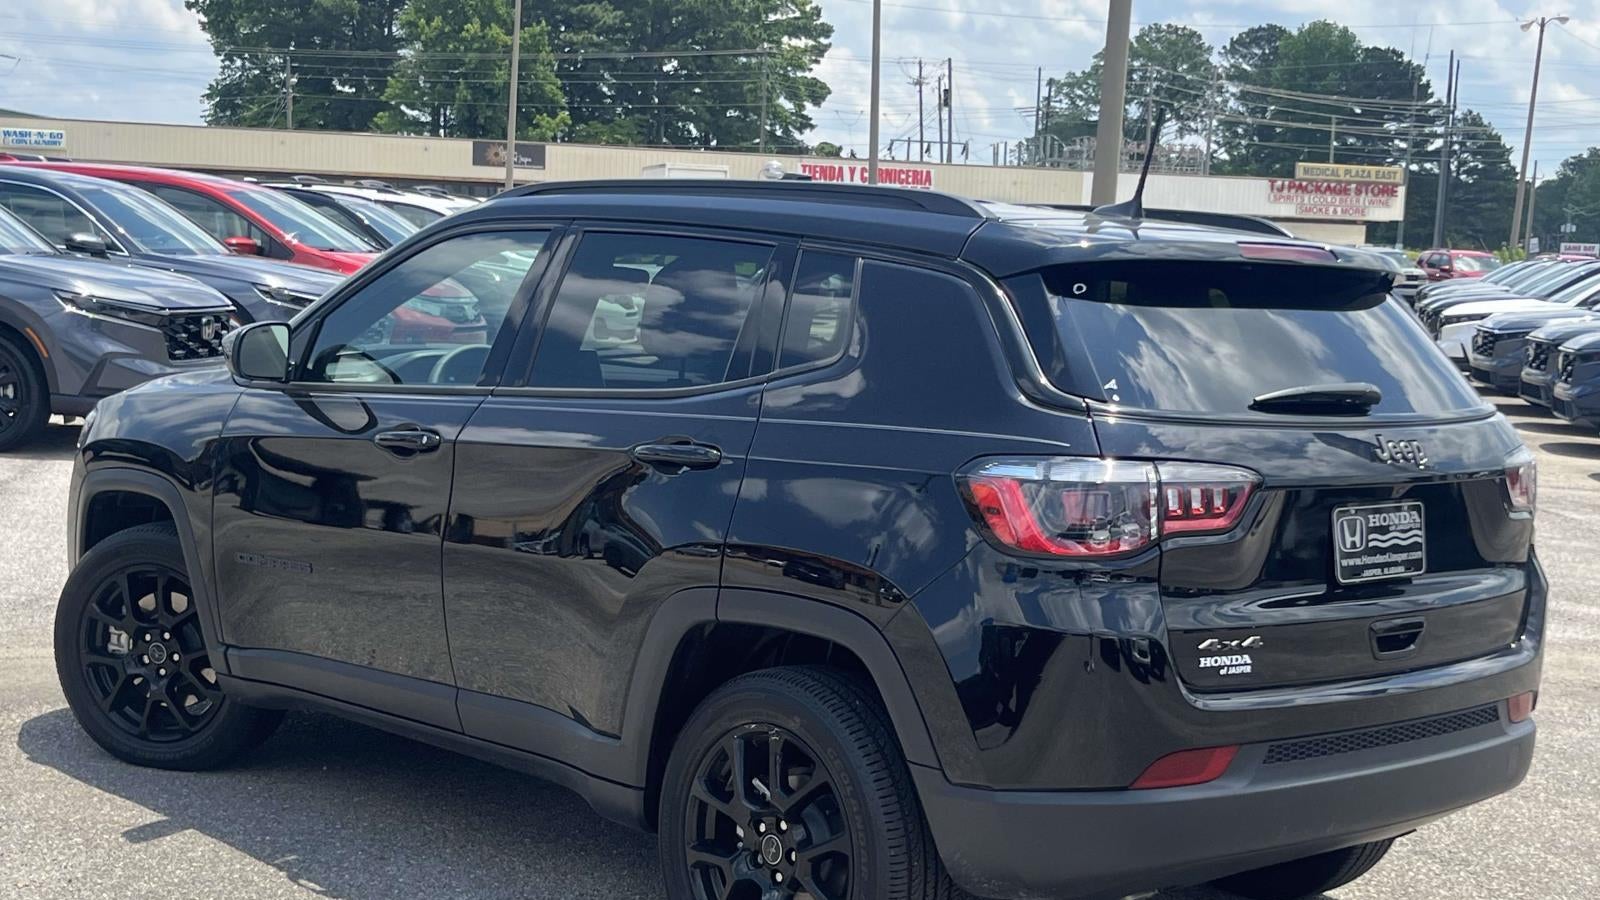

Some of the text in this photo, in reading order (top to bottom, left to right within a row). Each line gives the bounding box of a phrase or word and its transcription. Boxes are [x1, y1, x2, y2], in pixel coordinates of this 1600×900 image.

[2, 130, 32, 138] WASH
[49, 132, 63, 140] GO
[848, 166, 857, 183] Y
[860, 167, 932, 187] CRNICERIA
[1302, 167, 1399, 180] MEDICAL PLAZA EAST
[1268, 179, 1399, 198] TJ PACKAGE STORE
[1272, 194, 1391, 207] SPIRITS COLD BEER WINE
[1300, 206, 1330, 215] SMOKE
[1341, 208, 1367, 217] MORE
[1374, 434, 1428, 470] Jeep
[1368, 511, 1421, 527] HONDA
[1199, 654, 1252, 668] HONDA
[1219, 665, 1252, 675] of JASPER
